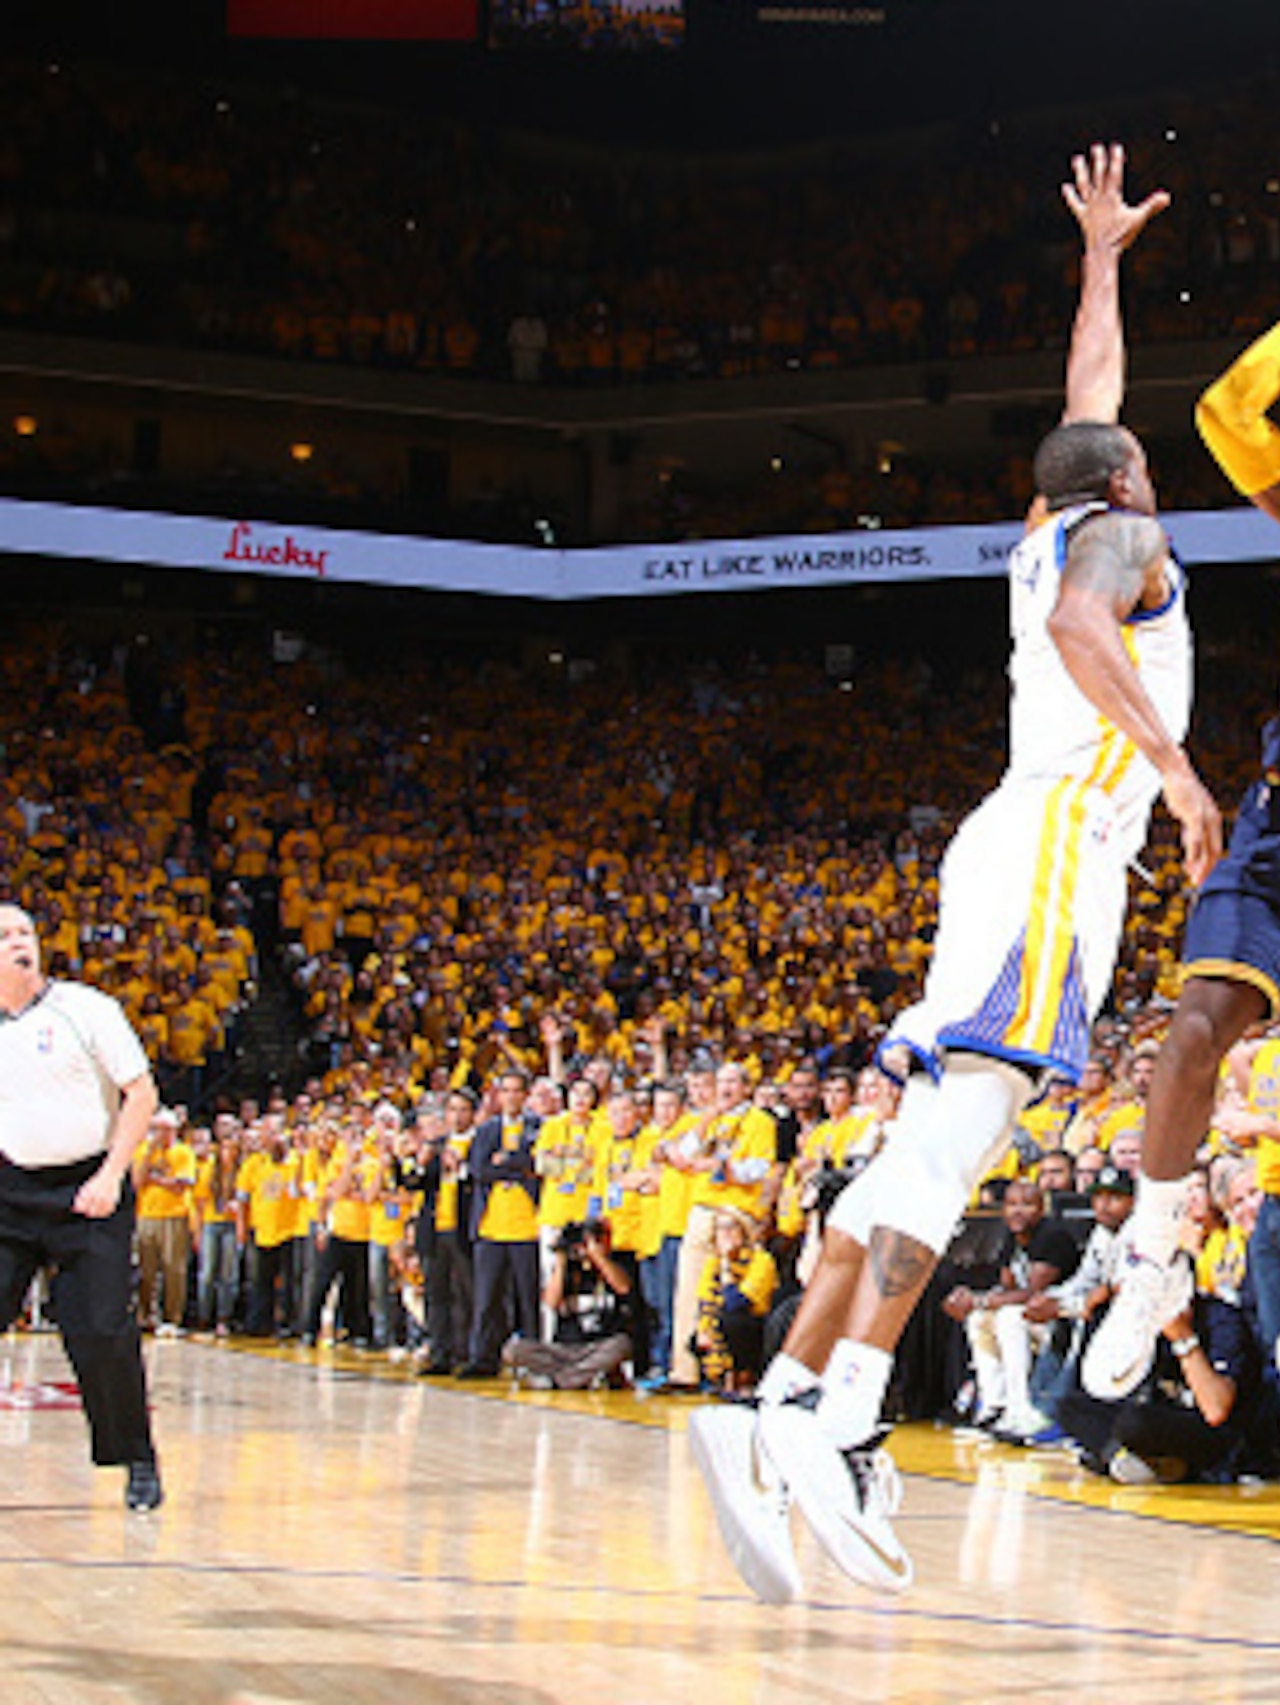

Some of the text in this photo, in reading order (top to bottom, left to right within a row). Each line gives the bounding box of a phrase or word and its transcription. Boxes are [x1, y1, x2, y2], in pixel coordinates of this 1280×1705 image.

[223, 521, 331, 577] Lucky
[644, 546, 931, 579] EAT LIKE WARRIORS.
